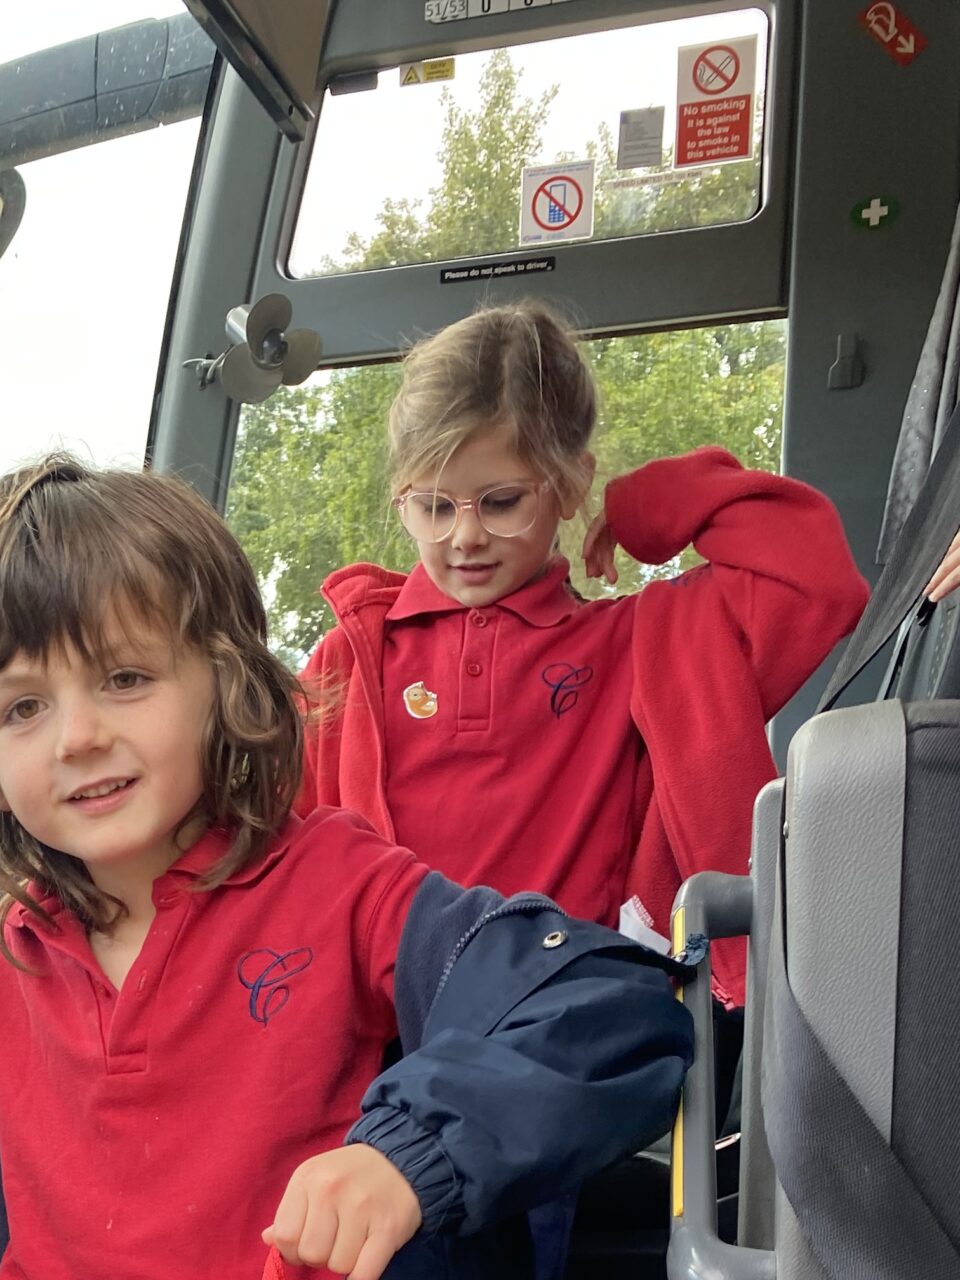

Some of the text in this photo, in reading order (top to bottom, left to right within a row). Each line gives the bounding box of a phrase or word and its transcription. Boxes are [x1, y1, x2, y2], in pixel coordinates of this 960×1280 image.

[683, 99, 746, 116] No smoking
[687, 113, 740, 128] It is against
[697, 126, 730, 137] the law
[687, 134, 740, 149] to smoke in
[687, 145, 739, 159] this vehicle
[444, 271, 469, 280] Please
[469, 268, 480, 277] do
[481, 267, 493, 275] not
[494, 264, 516, 274] speak
[517, 263, 525, 271] to
